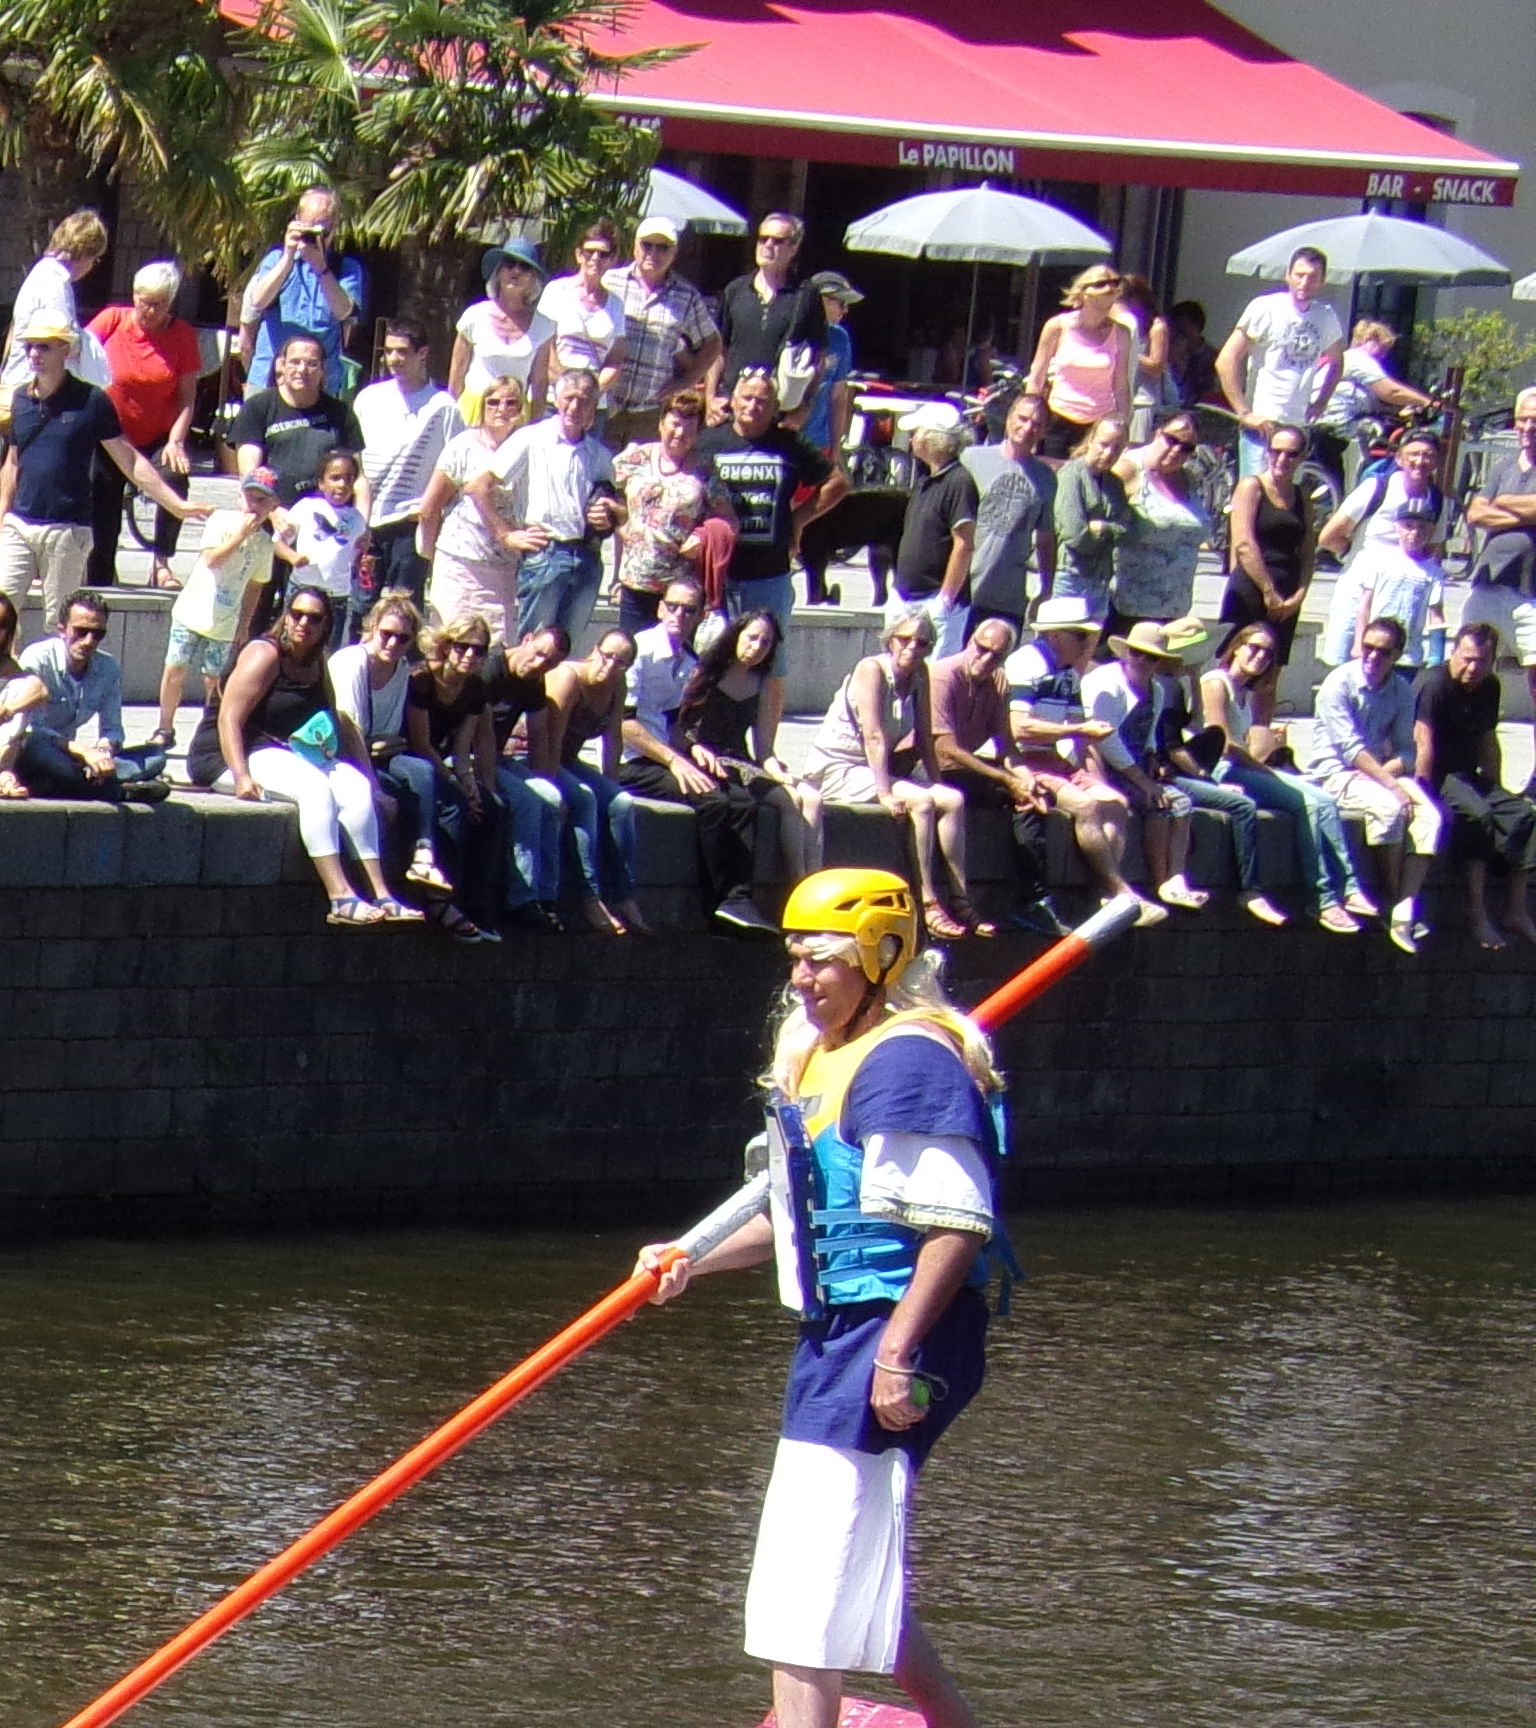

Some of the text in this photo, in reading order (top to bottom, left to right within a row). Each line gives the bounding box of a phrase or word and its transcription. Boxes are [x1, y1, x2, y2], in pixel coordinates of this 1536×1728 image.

[898, 141, 1014, 173] Le PAPILLON
[1366, 173, 1404, 198] BAR
[1432, 177, 1495, 203] SNACK
